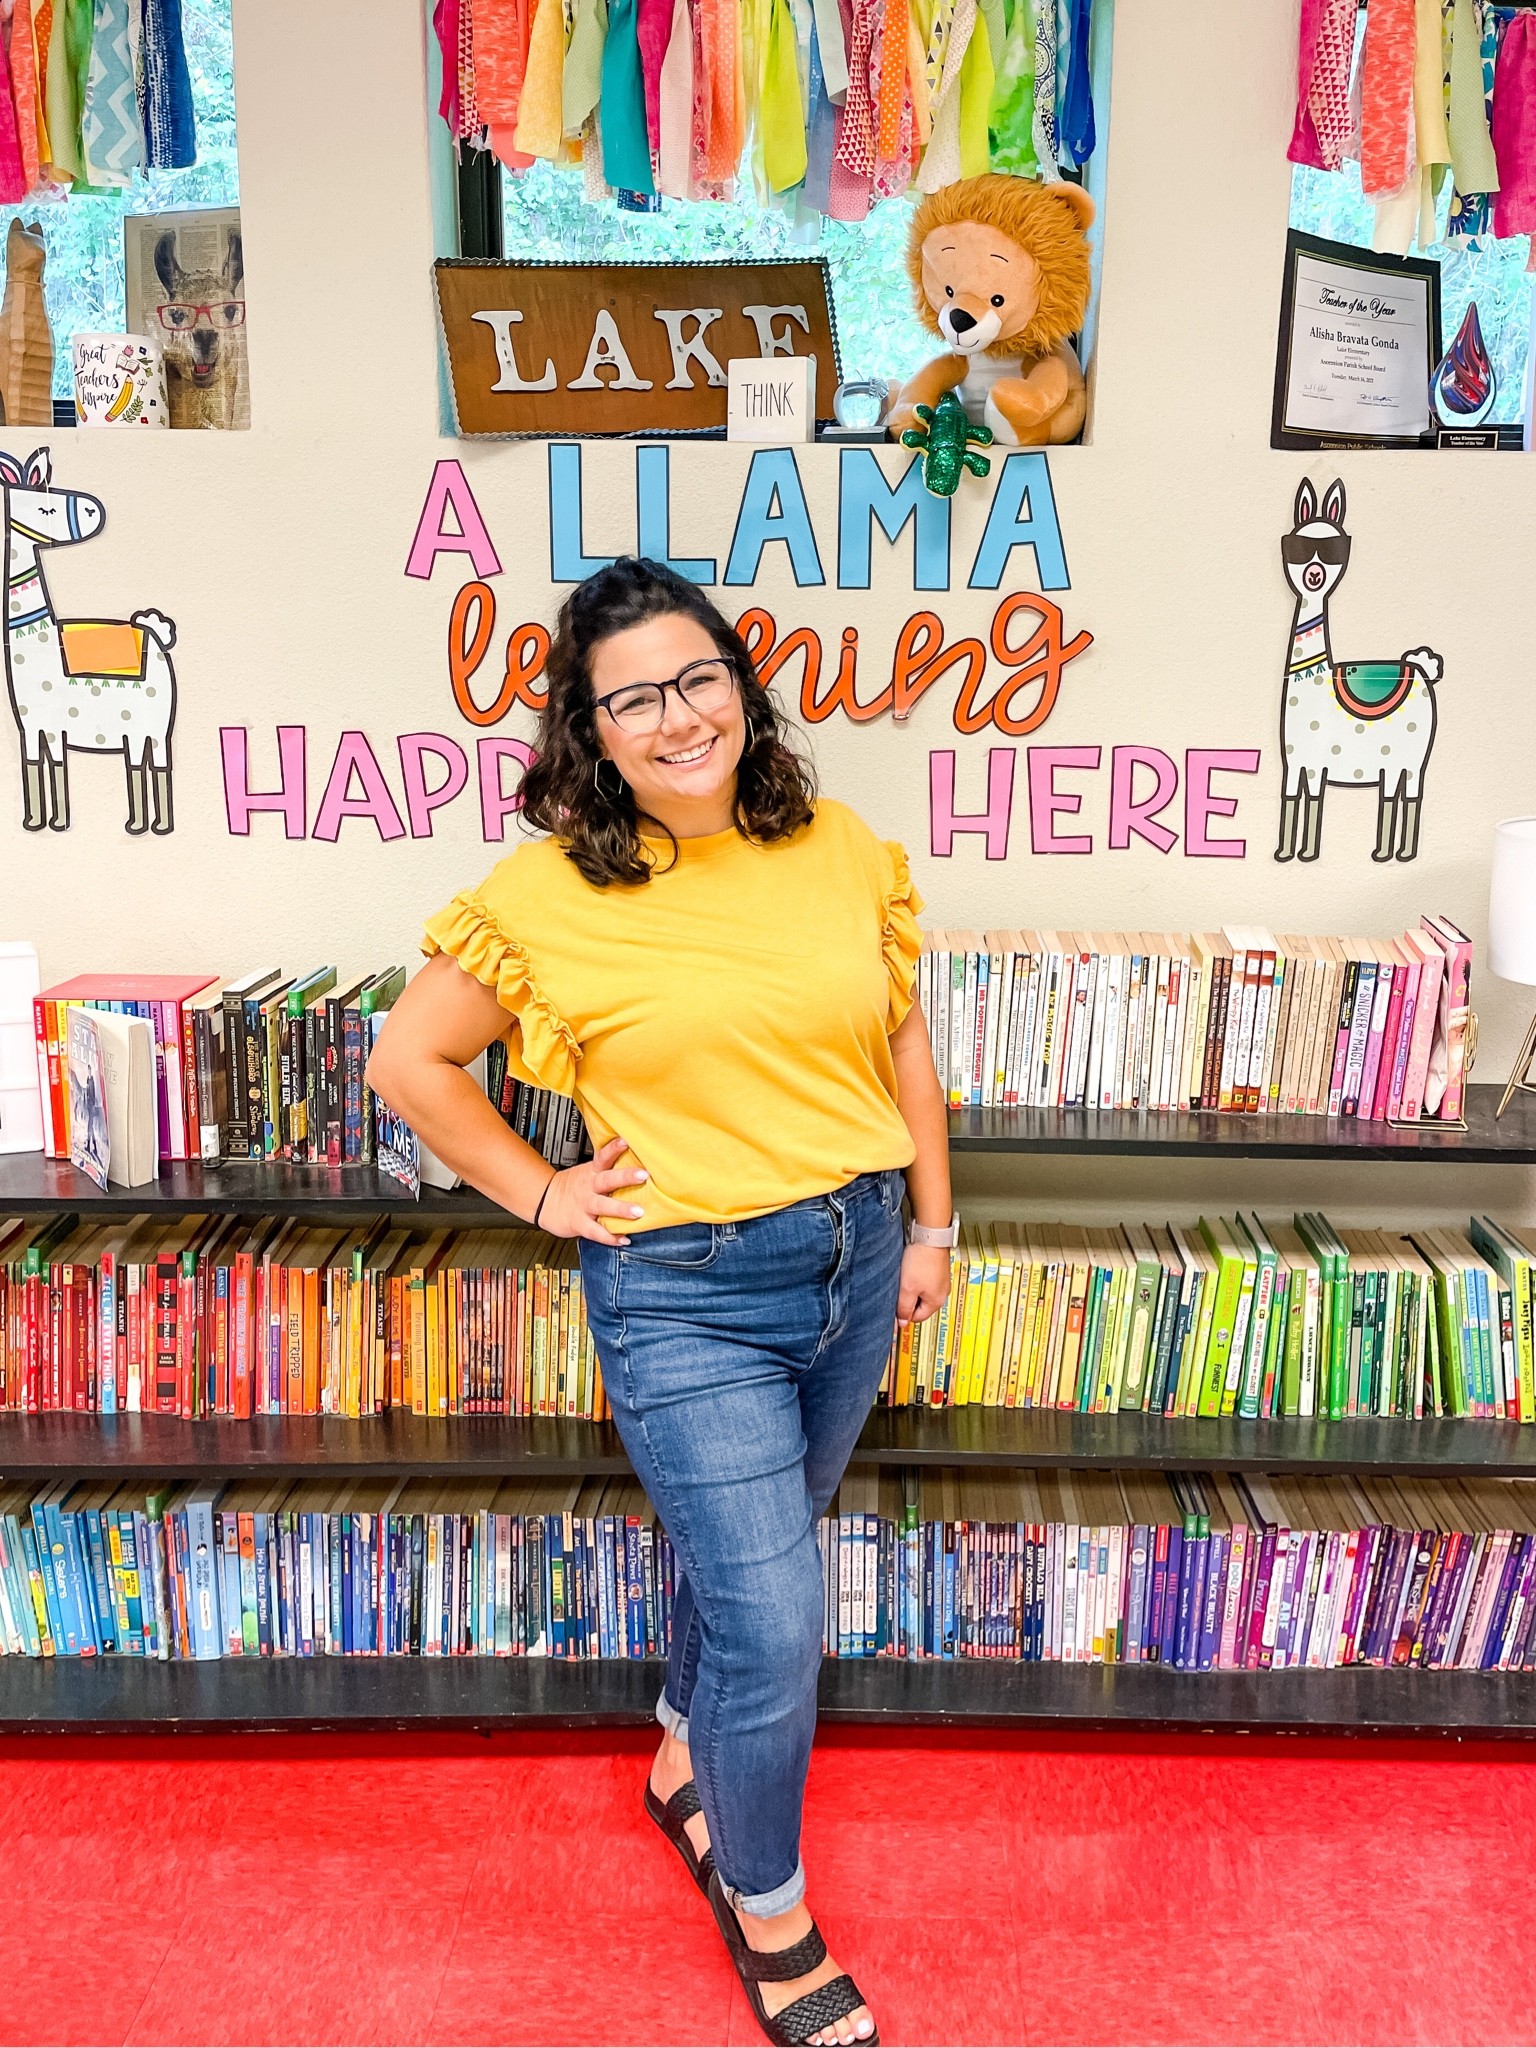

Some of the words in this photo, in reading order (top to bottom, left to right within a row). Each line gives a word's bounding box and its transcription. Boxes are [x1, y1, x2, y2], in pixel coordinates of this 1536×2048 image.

[1319, 287, 1348, 309] Teacher
[1348, 298, 1358, 315] of
[1357, 299, 1368, 312] the
[1370, 298, 1397, 319] Year
[471, 304, 814, 392] LAKE
[1310, 326, 1335, 342] Alisha
[1337, 330, 1369, 347] Bravata
[1371, 336, 1399, 351] Gonda
[80, 343, 111, 369] Great
[75, 368, 119, 390] Teachers
[82, 386, 118, 411] Inspire
[741, 382, 797, 418] THINK
[1319, 440, 1347, 450] Ascension
[405, 459, 506, 580] A
[548, 442, 1072, 591] LLAMA
[448, 581, 1093, 736] lening
[219, 725, 545, 844] HAPP
[929, 746, 1262, 862] HERE
[1049, 990, 1057, 1006] The
[1355, 993, 1371, 1028] SNICKER
[35, 1006, 43, 1034] NAYLOR
[940, 1008, 946, 1017] W.
[965, 995, 973, 1029] TOUCHING
[976, 1005, 984, 1040] POPPER'S
[1044, 1008, 1055, 1038] Magic
[952, 1026, 960, 1052] Moffats
[974, 1043, 983, 1083] PENGUINS
[1042, 1042, 1052, 1065] Trap
[1350, 1038, 1364, 1067] MAGIC
[281, 1055, 290, 1085] STOLEN
[282, 1087, 291, 1107] GIRL
[249, 1105, 259, 1136] Shadows
[947, 1255, 955, 1269] The
[103, 1279, 112, 1303] TELL
[238, 1278, 246, 1296] THE
[1021, 1268, 1029, 1288] LORD
[1031, 1269, 1040, 1289] Roald
[1260, 1270, 1271, 1305] KATFISH
[162, 1300, 170, 1310] for
[391, 1294, 399, 1313] JUDY
[1029, 1290, 1038, 1308] Dahl
[1502, 1296, 1511, 1320] Wallace
[103, 1307, 111, 1321] ME
[237, 1300, 245, 1344] TRADING
[289, 1313, 299, 1337] FIELD
[1016, 1307, 1024, 1333] handful
[937, 1322, 946, 1356] Almanac
[1291, 1321, 1300, 1339] Ruby
[1522, 1320, 1531, 1340] Pigza
[1254, 1330, 1263, 1357] CREATURE
[1290, 1340, 1299, 1360] Holler
[103, 1324, 112, 1392] EVERYTHING
[237, 1348, 245, 1377] GAME
[290, 1339, 300, 1378] TRIPPED
[936, 1358, 945, 1370] for
[935, 1371, 944, 1388] Kids
[1211, 1363, 1222, 1393] FUNNIEST
[1248, 1375, 1256, 1394] CLOSET
[257, 1548, 265, 1564] How
[627, 1533, 637, 1556] Santa
[1213, 1537, 1221, 1560] SEWELL
[37, 1525, 48, 1554] SPINELLI
[44, 1565, 54, 1596] STARGIRL
[629, 1558, 637, 1580] Paws
[1037, 1547, 1045, 1583] BUFFALO
[1286, 1555, 1296, 1584] QUINN
[55, 1559, 68, 1599] Sisters
[258, 1574, 267, 1597] SPEAK
[1025, 1566, 1033, 1605] CROCKETT
[1168, 1573, 1177, 1595] HOLES
[1208, 1572, 1218, 1599] BLACK
[1231, 1564, 1241, 1587] DORK
[1411, 1573, 1425, 1599] WINGS
[1253, 1579, 1268, 1613] Braced
[1205, 1602, 1215, 1634] BEAUTY
[1407, 1603, 1419, 1621] FIRE
